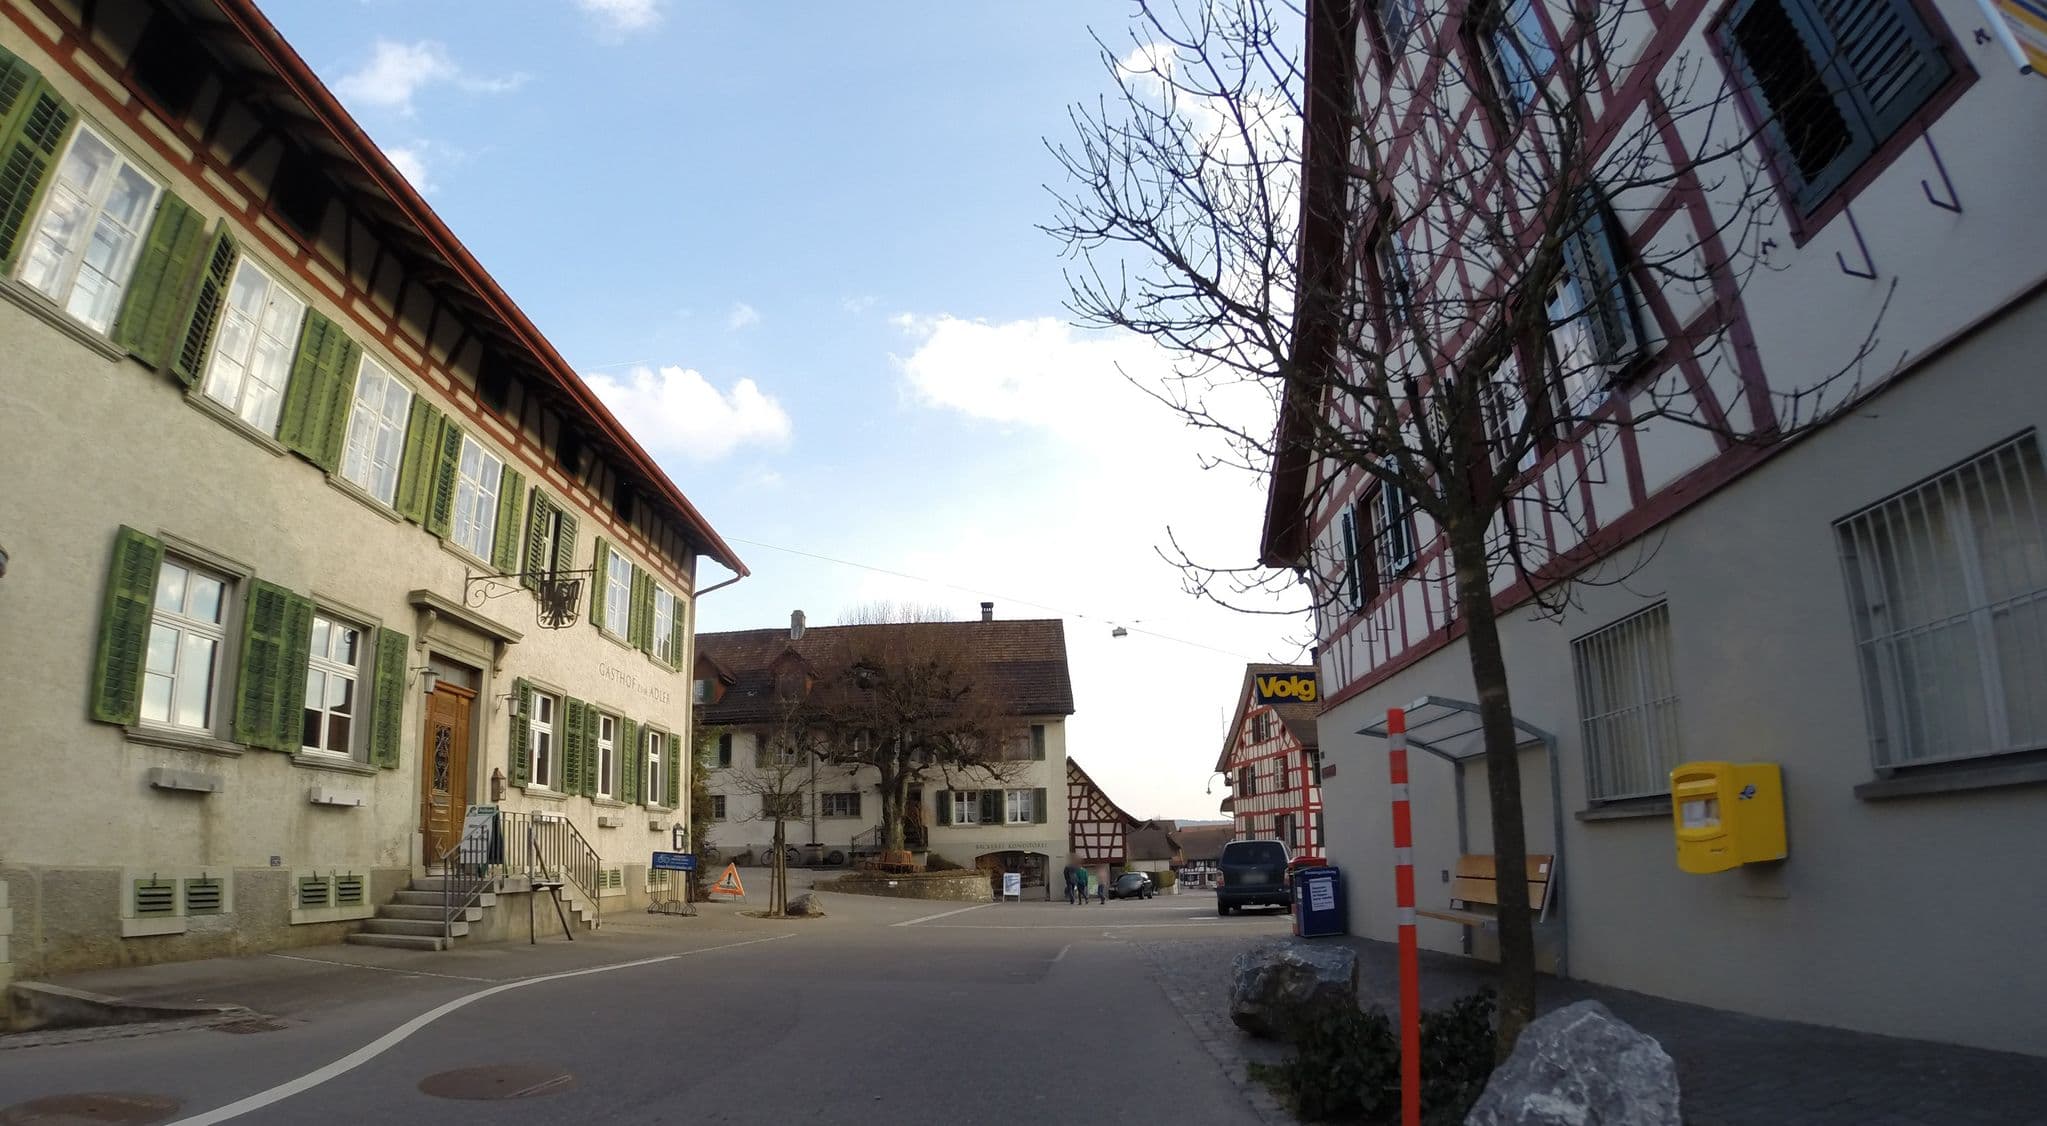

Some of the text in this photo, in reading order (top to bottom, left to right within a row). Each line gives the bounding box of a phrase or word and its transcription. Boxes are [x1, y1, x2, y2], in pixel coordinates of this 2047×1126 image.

[599, 663, 637, 689] GASTHOF
[650, 687, 670, 704] ADLER
[1257, 675, 1315, 701] Volg
